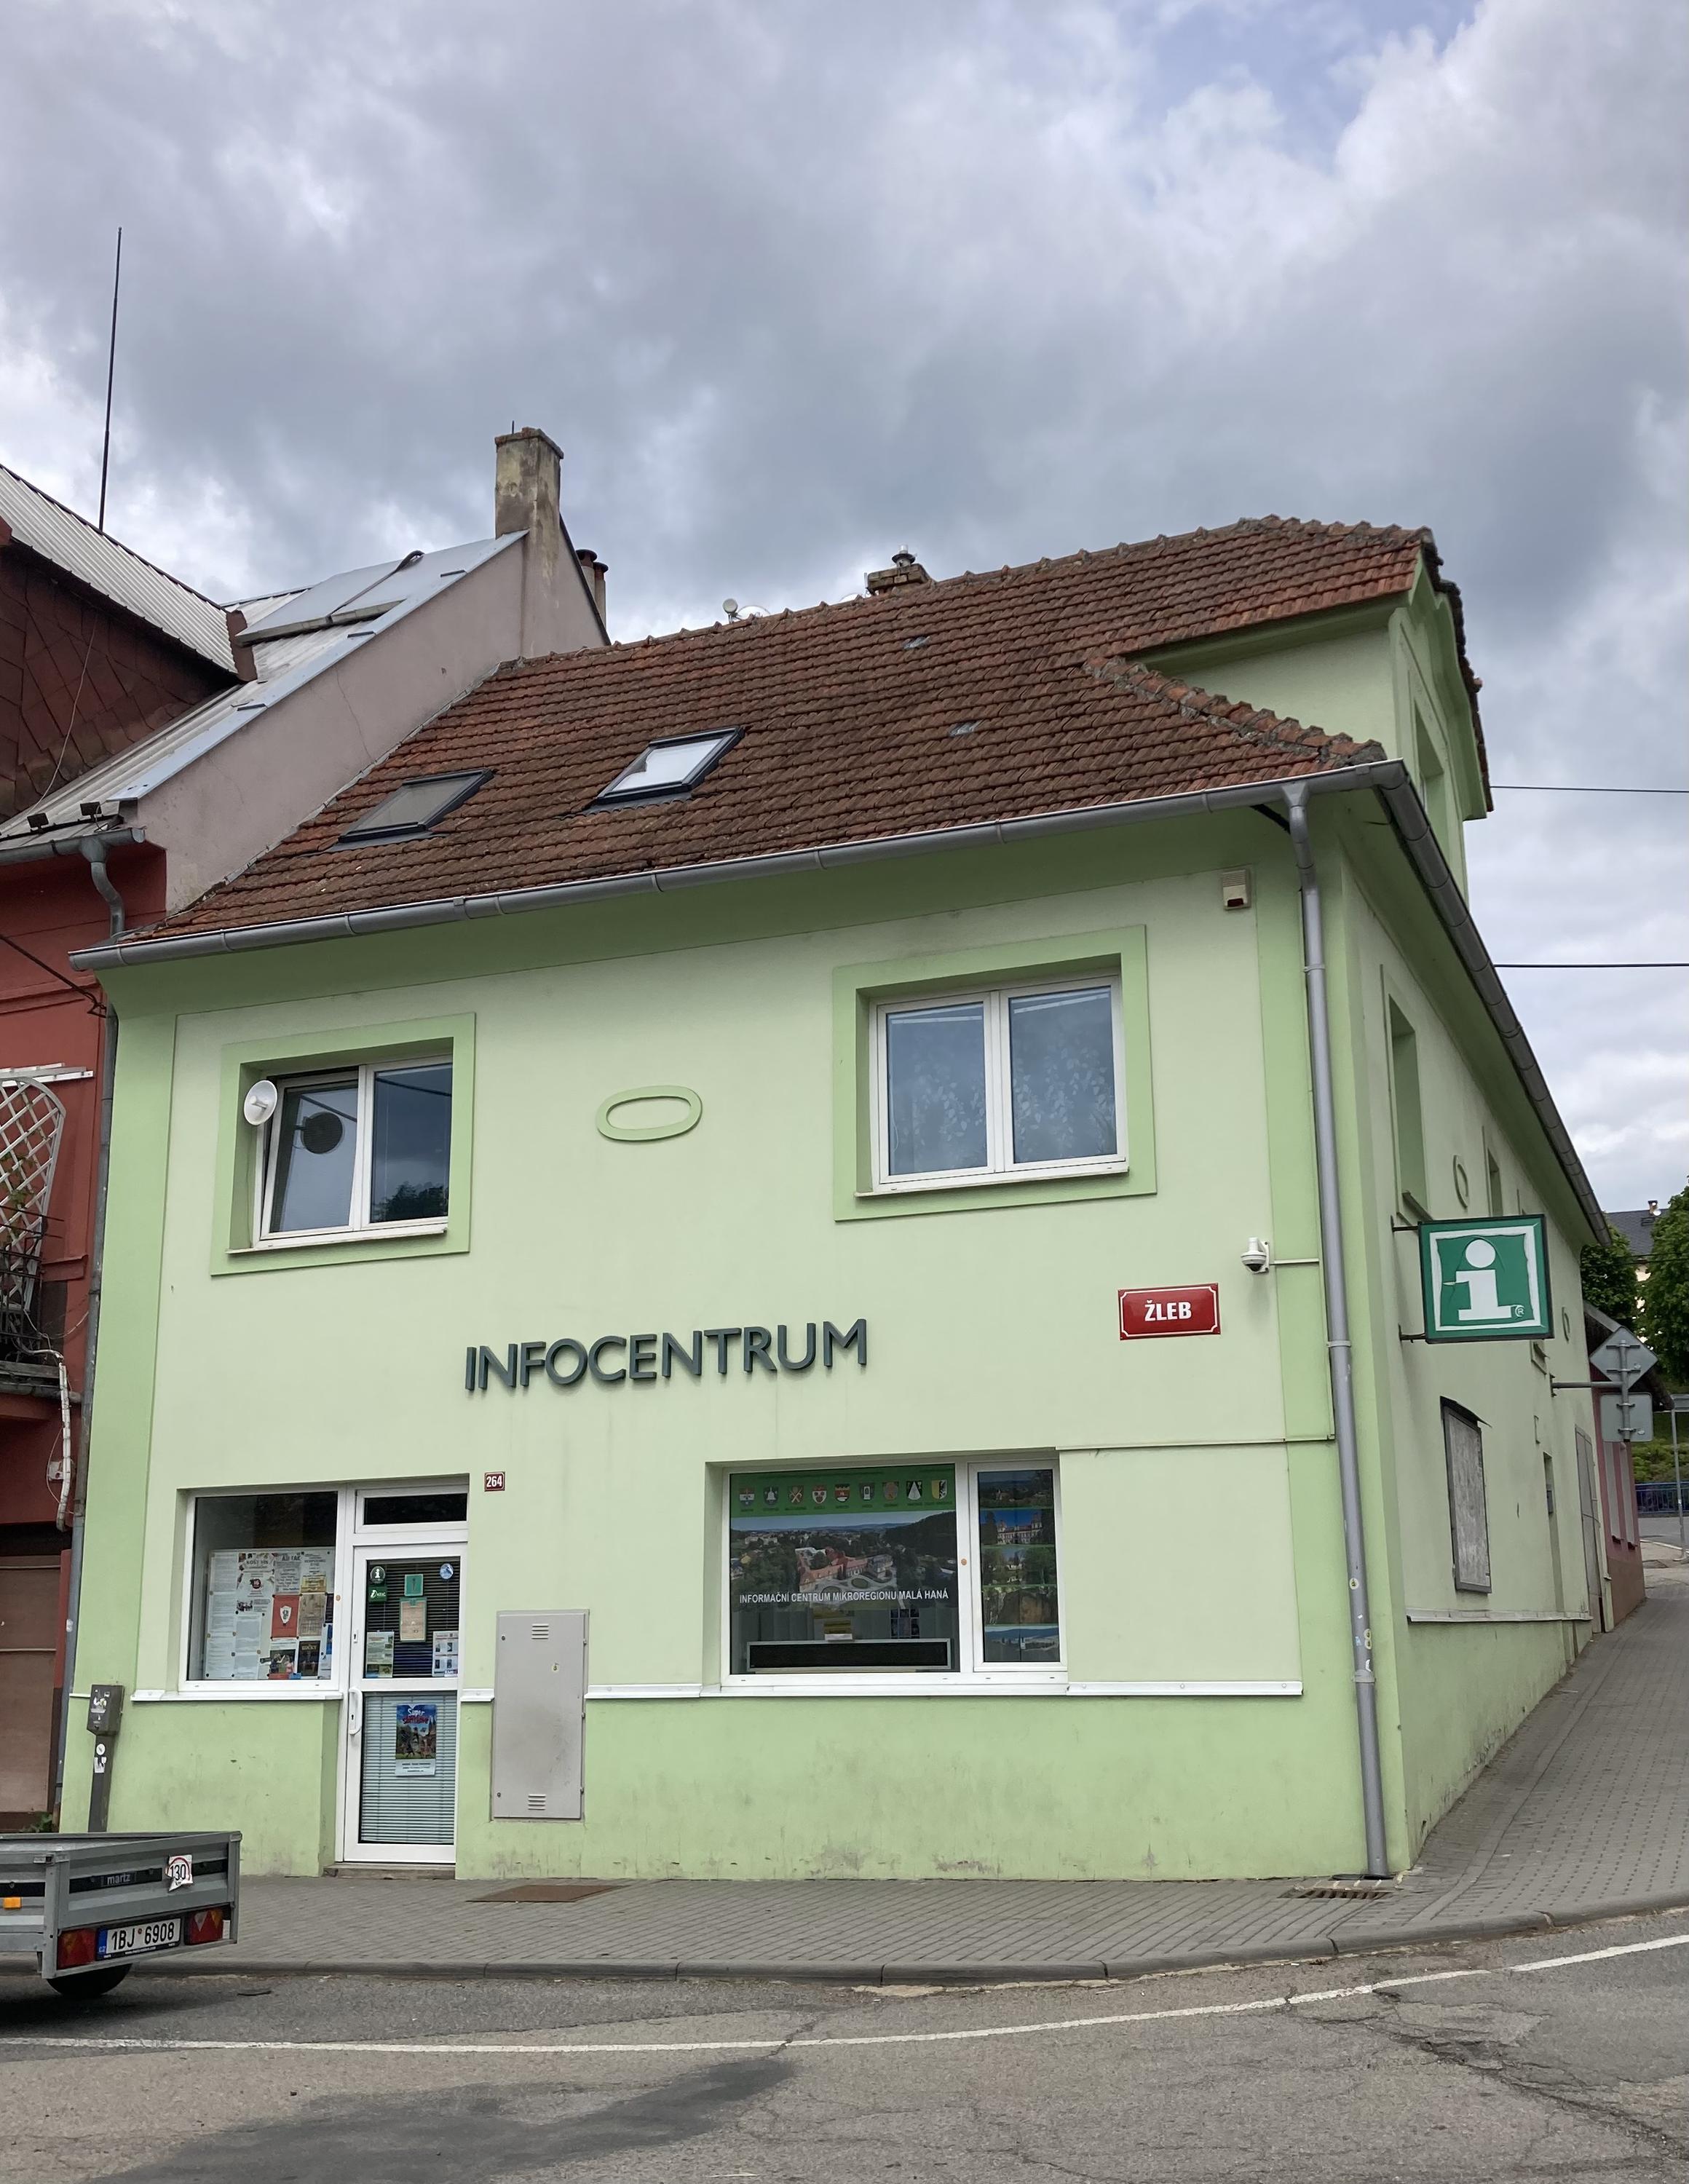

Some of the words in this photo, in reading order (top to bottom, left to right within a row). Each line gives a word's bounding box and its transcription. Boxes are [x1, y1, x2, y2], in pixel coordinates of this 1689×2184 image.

[1144, 1299, 1192, 1322] ŽLEB
[465, 1318, 867, 1391] INFOCENTRUM
[486, 1475, 502, 1488] 264
[740, 1591, 789, 1603] INFORMAČNÍ
[791, 1592, 831, 1602] CENTRUM
[833, 1590, 897, 1601] MIKROREGIONU
[898, 1588, 922, 1600] MALÁ
[925, 1588, 949, 1599] HANÁ
[170, 1864, 186, 1881] 130
[111, 1928, 135, 1950] 1BJ
[145, 1922, 175, 1944] 6908
